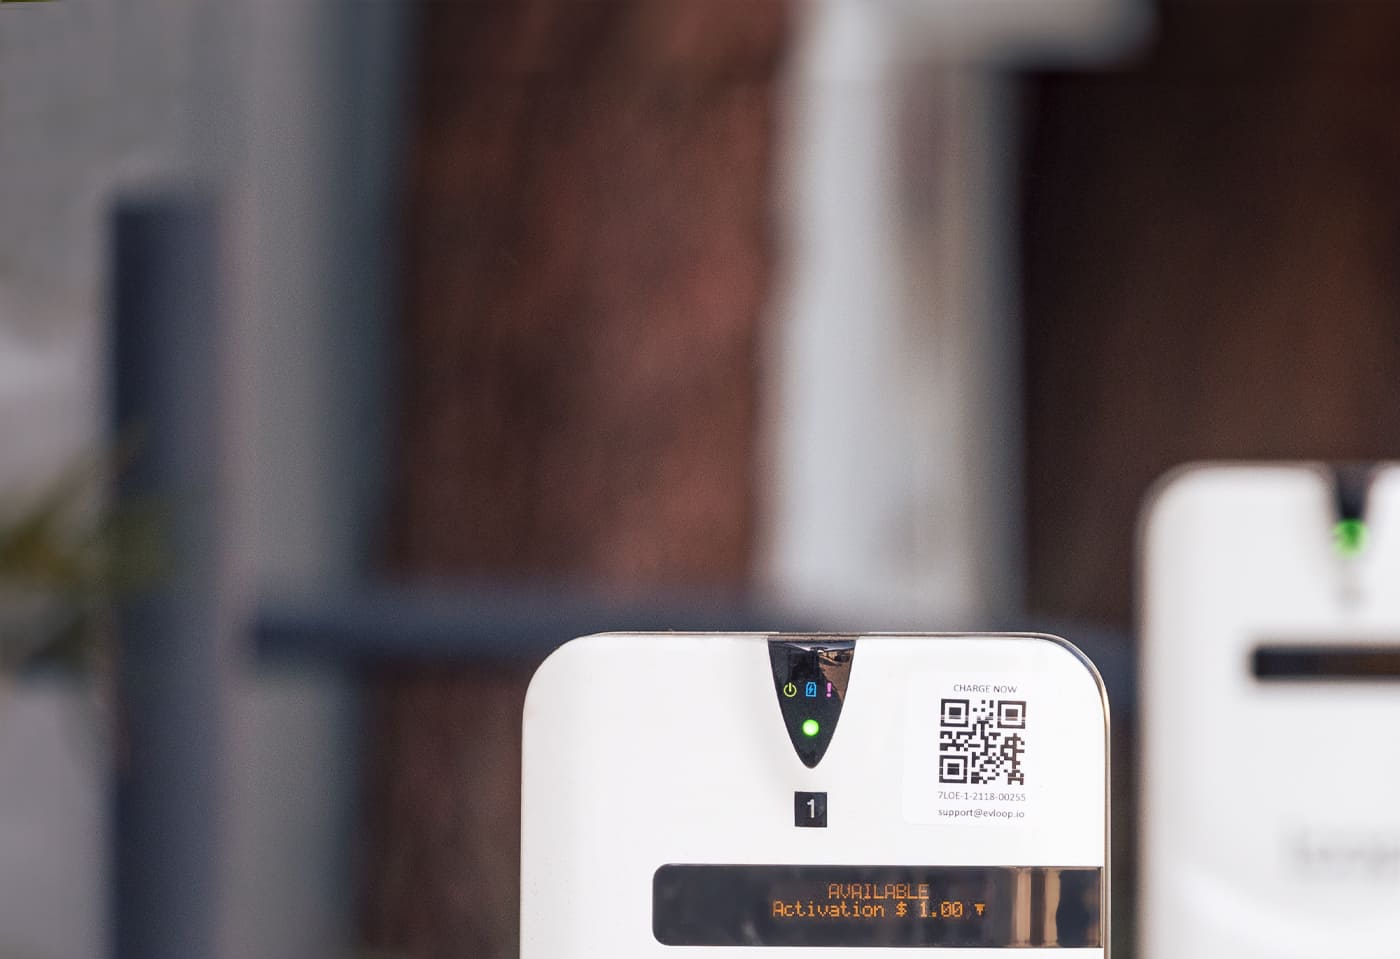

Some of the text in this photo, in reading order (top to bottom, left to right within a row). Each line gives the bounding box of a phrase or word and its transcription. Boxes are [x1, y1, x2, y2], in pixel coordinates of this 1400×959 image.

[953, 684, 1018, 694] CHARGE NOW
[806, 798, 815, 819] 1
[938, 809, 1025, 819] support@evloop.io
[828, 883, 930, 900] AVAILABLE
[772, 901, 964, 918] Activation $ 1.00
